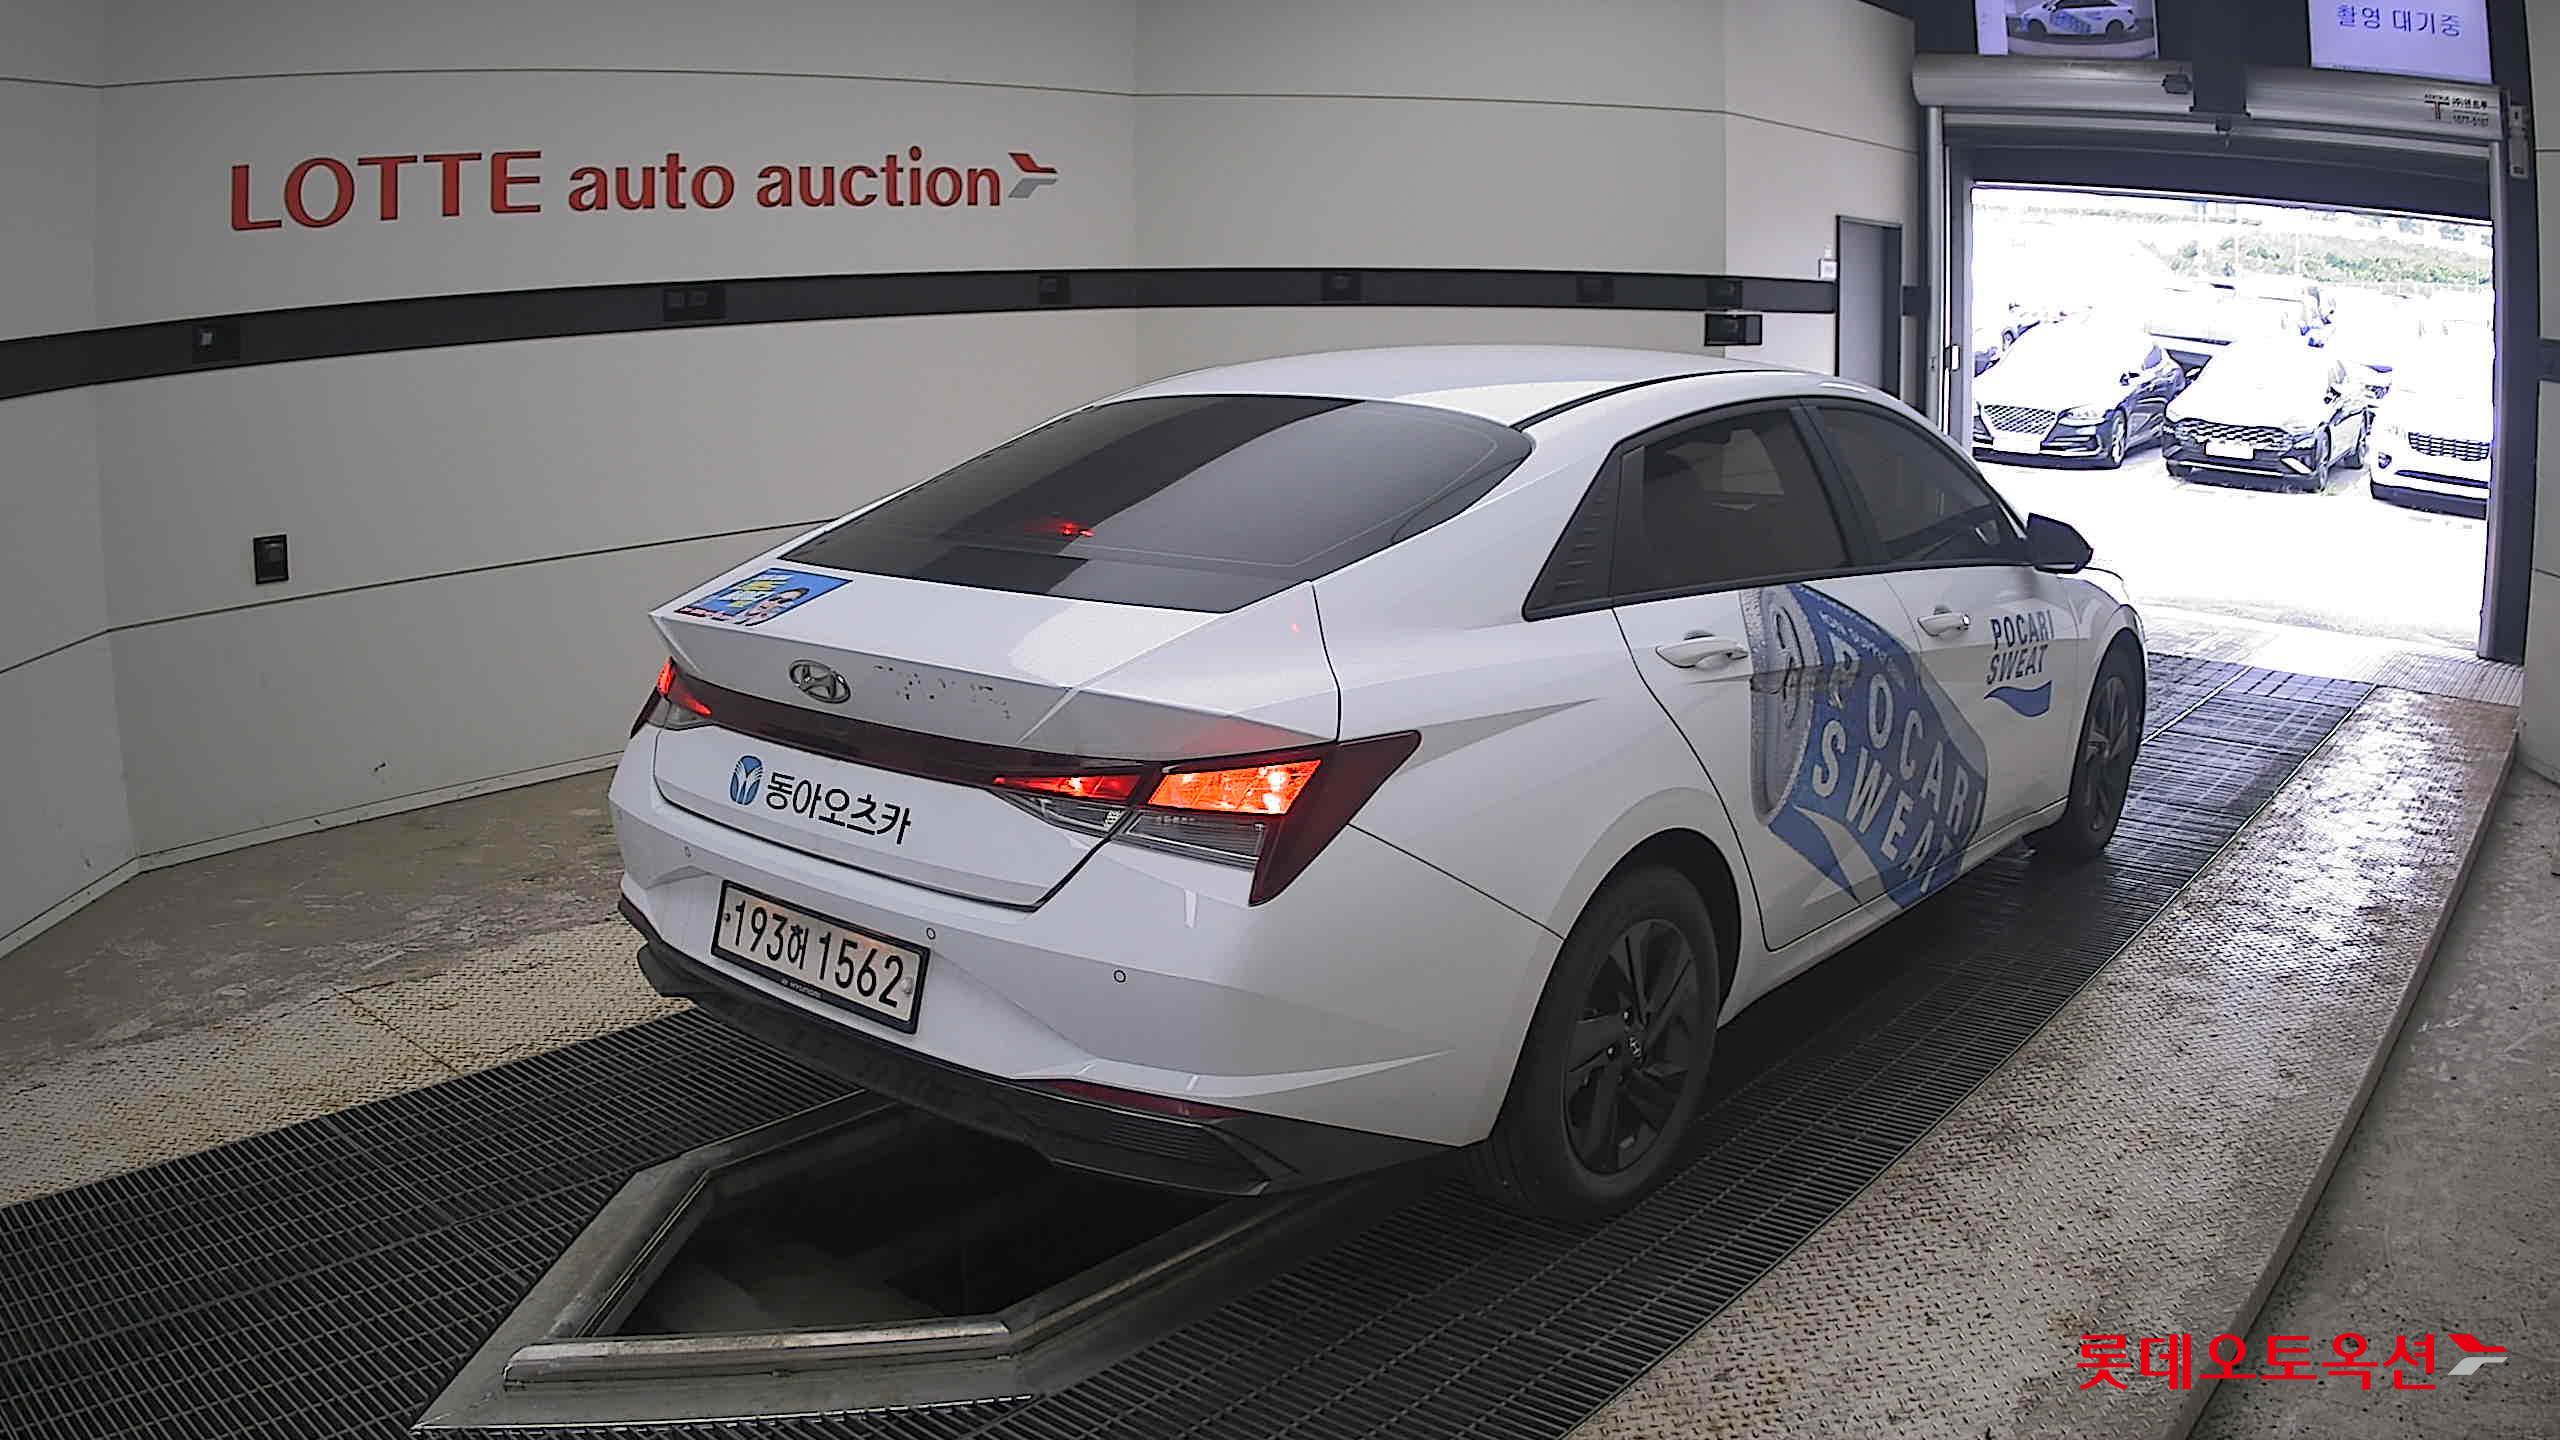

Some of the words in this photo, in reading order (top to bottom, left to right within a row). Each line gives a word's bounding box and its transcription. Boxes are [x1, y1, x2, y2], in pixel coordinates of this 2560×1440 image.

[2337, 4, 2381, 29] 촬영
[2393, 9, 2460, 37] 대기중
[231, 150, 542, 231] LOTTE
[568, 152, 735, 210] auto
[756, 146, 1001, 207] auction
[1986, 645, 2049, 685] SWEAT
[1990, 608, 2056, 648] POCARI
[1827, 630, 1986, 836] POCARI
[765, 771, 912, 845] 동아오츠카
[1812, 719, 1955, 895] SWEAT
[734, 899, 810, 970] 193허
[818, 931, 905, 1009] 1562
